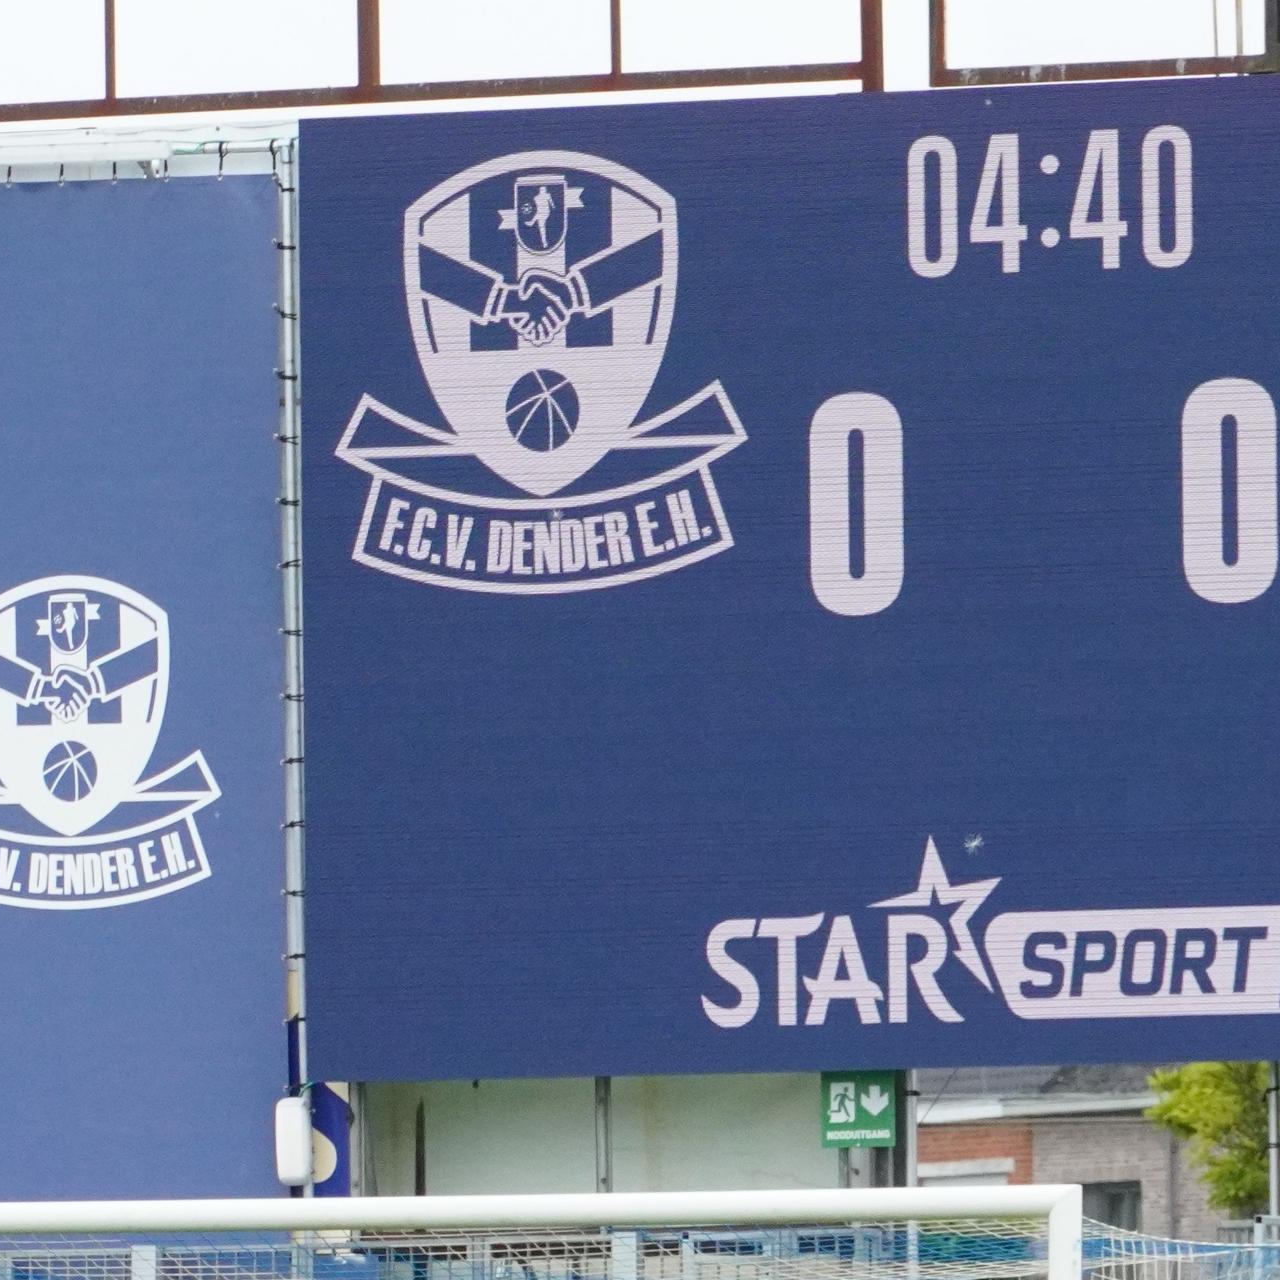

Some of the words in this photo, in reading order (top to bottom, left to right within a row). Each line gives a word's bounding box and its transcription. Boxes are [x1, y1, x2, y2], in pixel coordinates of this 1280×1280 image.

[907, 124, 1193, 278] 04:40
[378, 497, 476, 572] F.C.V.
[487, 516, 634, 576] DENDER
[635, 489, 712, 557] E.H.
[809, 391, 904, 616] 0
[1181, 377, 1279, 604] 0
[28, 847, 138, 895] DENDER
[139, 832, 196, 883] E.H.
[700, 912, 965, 1029] STAR
[1019, 926, 1268, 999] SPORT
